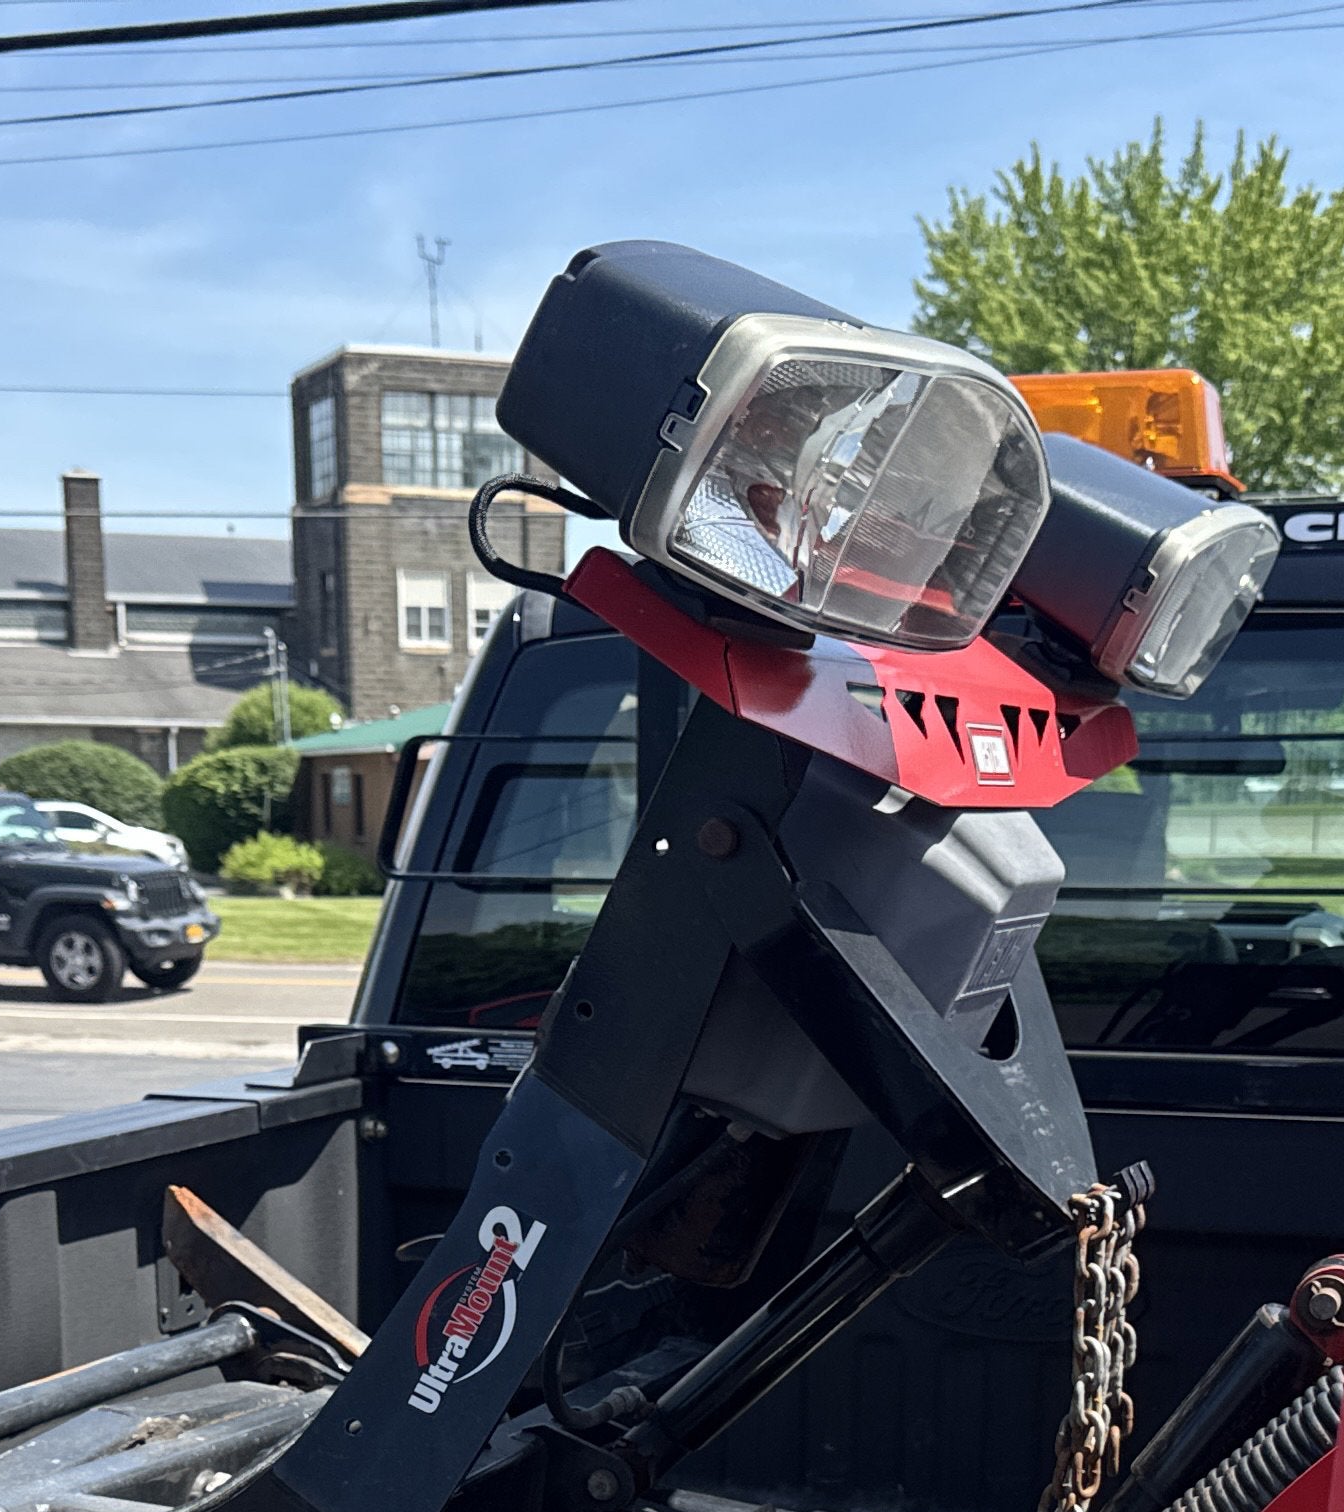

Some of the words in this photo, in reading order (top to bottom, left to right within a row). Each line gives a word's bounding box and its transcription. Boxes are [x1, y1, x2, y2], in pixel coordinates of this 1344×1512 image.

[407, 1235, 520, 1415] UltraMount
[478, 1205, 548, 1271] 2
[459, 1266, 482, 1304] SYSTEM
